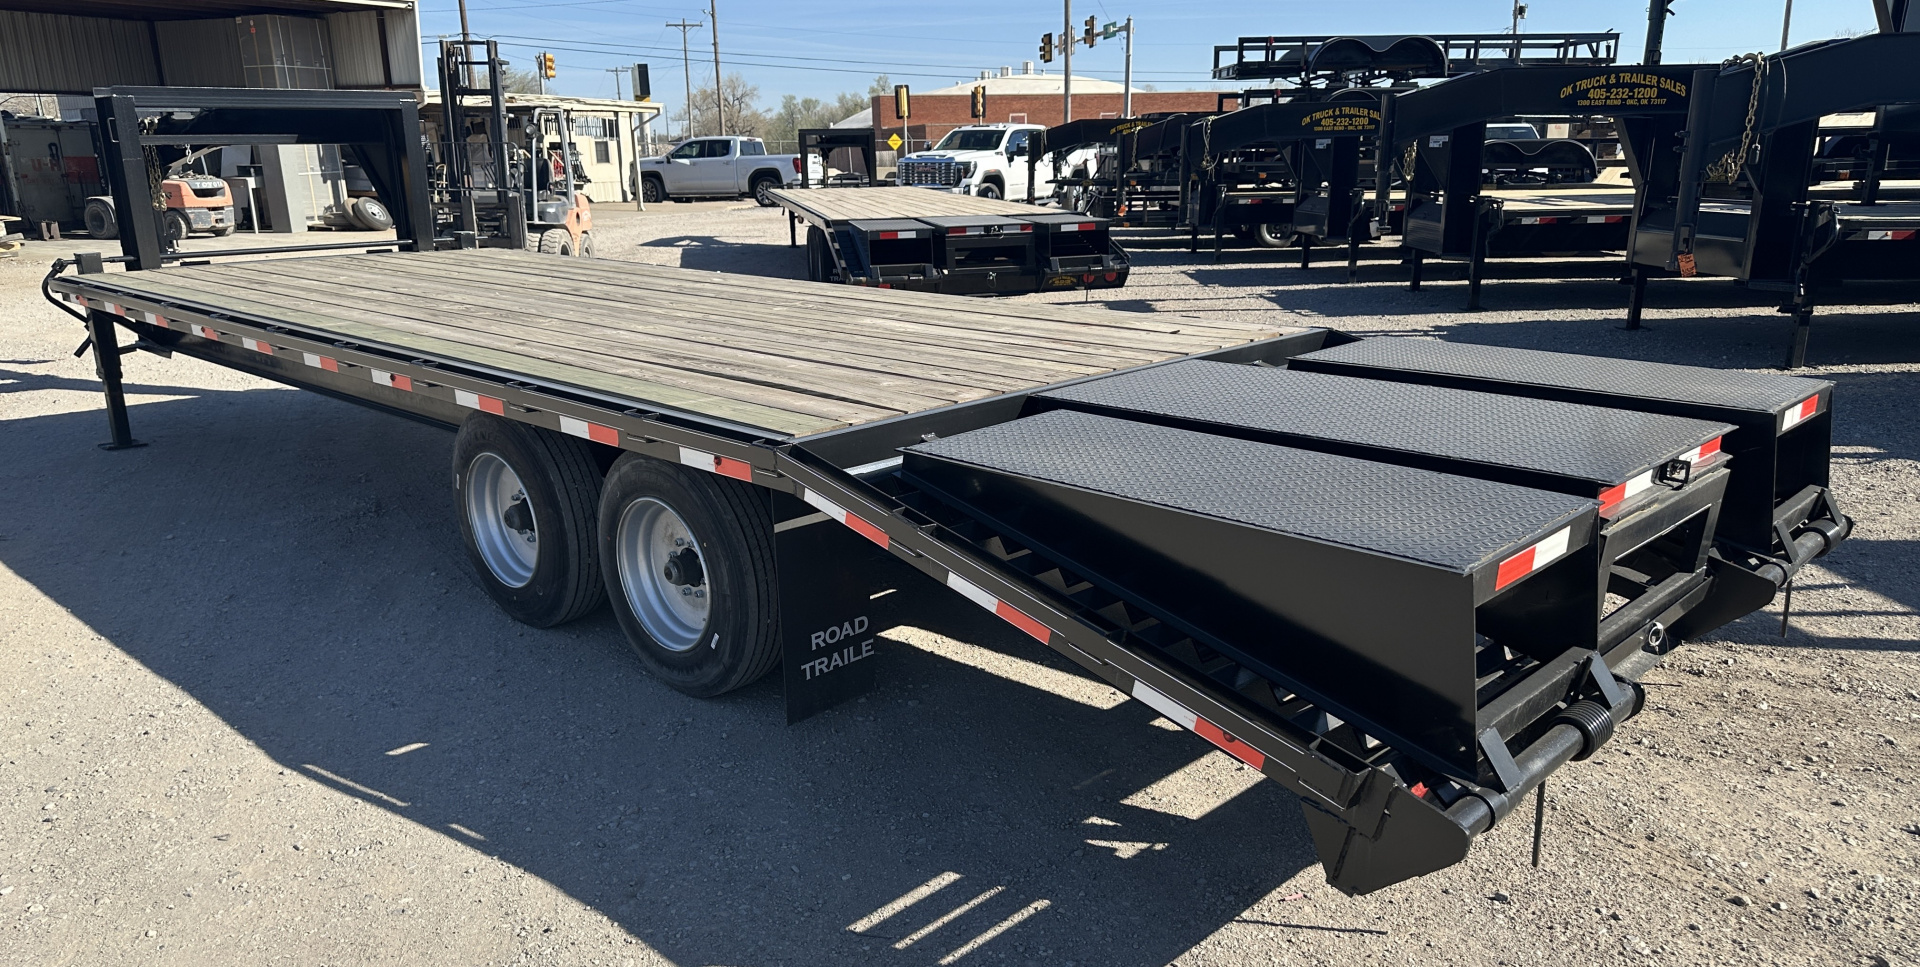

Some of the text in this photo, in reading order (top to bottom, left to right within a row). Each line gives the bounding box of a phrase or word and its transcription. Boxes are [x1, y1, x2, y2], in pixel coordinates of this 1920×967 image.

[1560, 73, 1686, 99] OK TRUCK & TRAILER SALES
[1588, 88, 1658, 99] 405-232-1200
[1301, 115, 1311, 126] OK
[1312, 109, 1334, 120] TRUCK
[1341, 106, 1369, 117] TRAILER
[1320, 117, 1369, 126] 405-232-1200
[810, 615, 869, 651] ROAD
[800, 638, 875, 681] TRAILE
